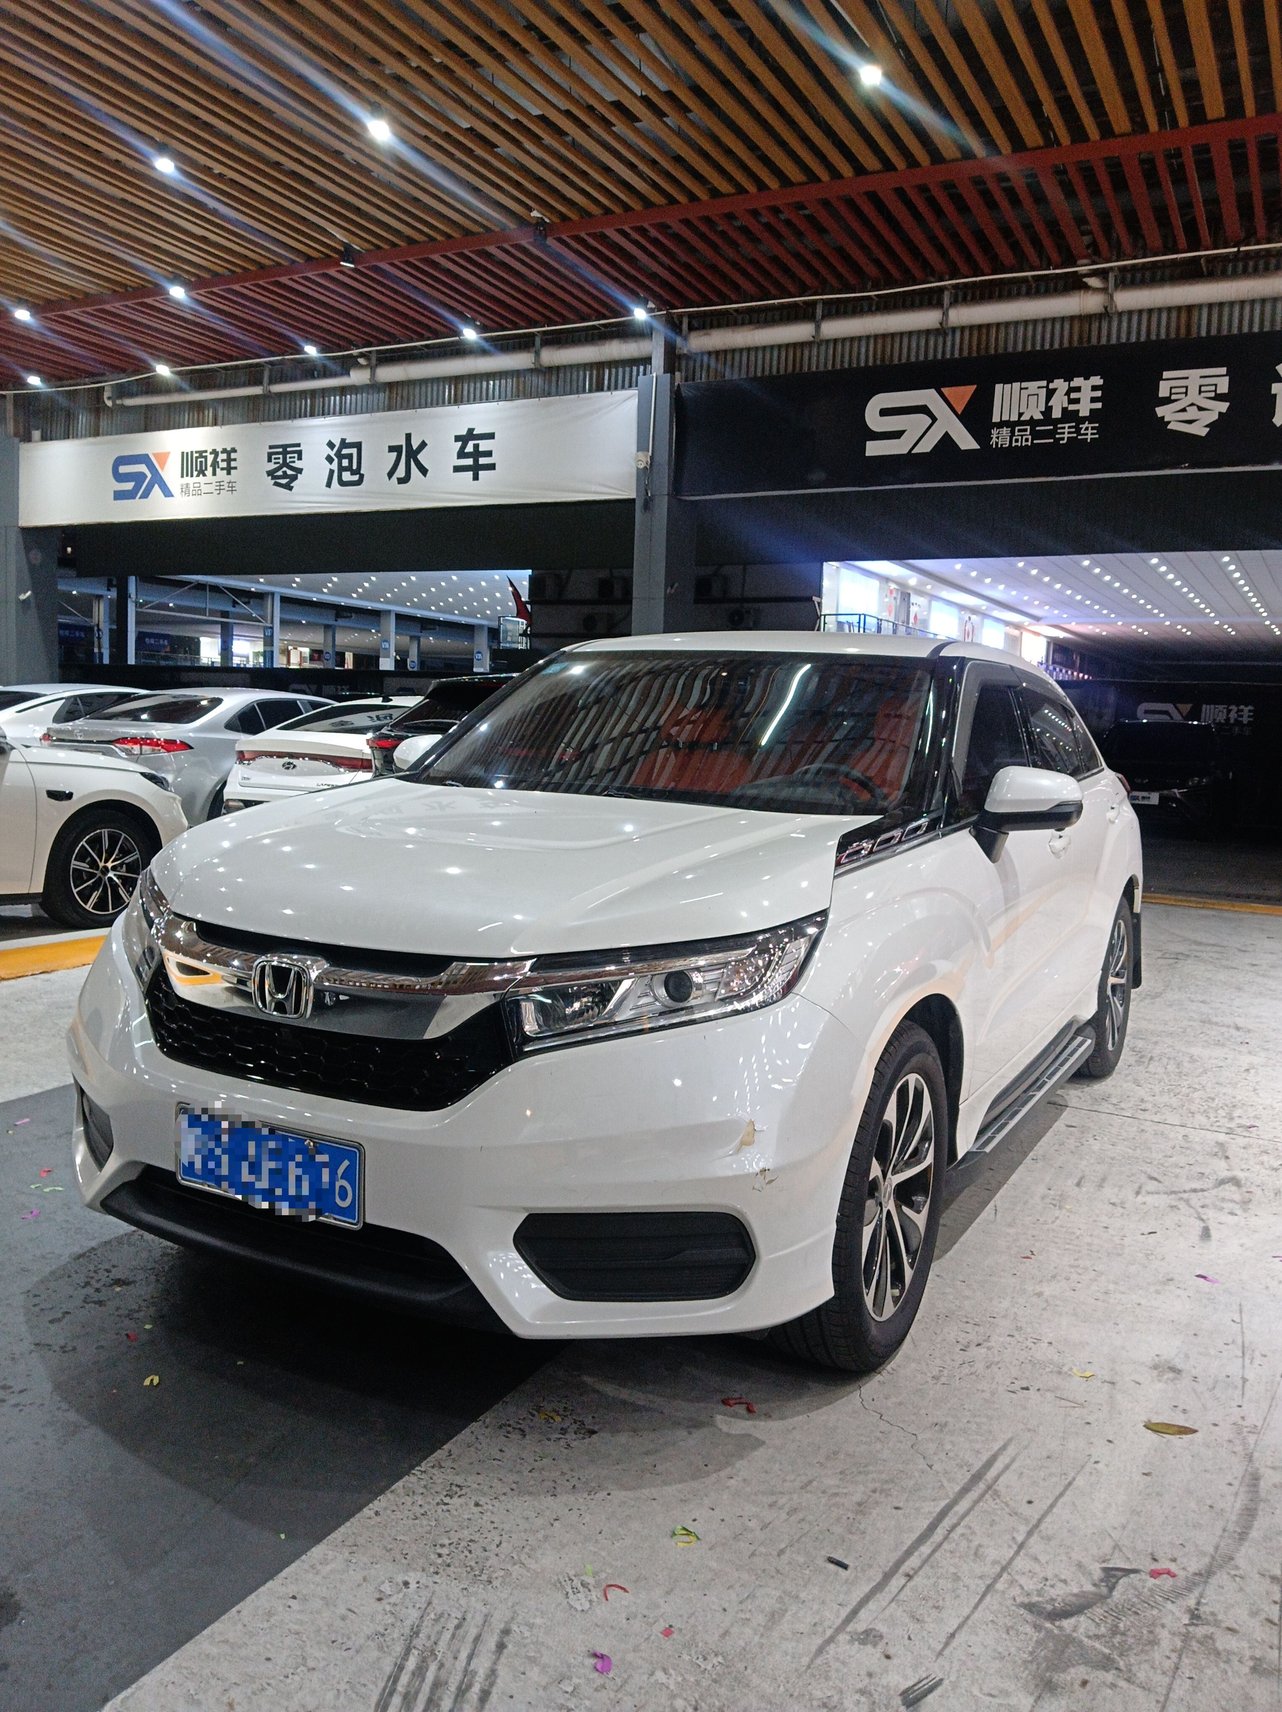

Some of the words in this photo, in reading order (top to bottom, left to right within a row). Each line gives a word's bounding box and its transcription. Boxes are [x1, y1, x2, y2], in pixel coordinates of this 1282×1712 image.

[992, 376, 1104, 422] 顺祥
[865, 385, 981, 456] SX
[990, 421, 1099, 448] 精品二手车
[112, 452, 174, 501] SX
[180, 447, 238, 478] 顺祥
[266, 428, 496, 491] 零泡水车
[180, 480, 237, 497] 精品二手车
[1201, 704, 1254, 724] 顺祥
